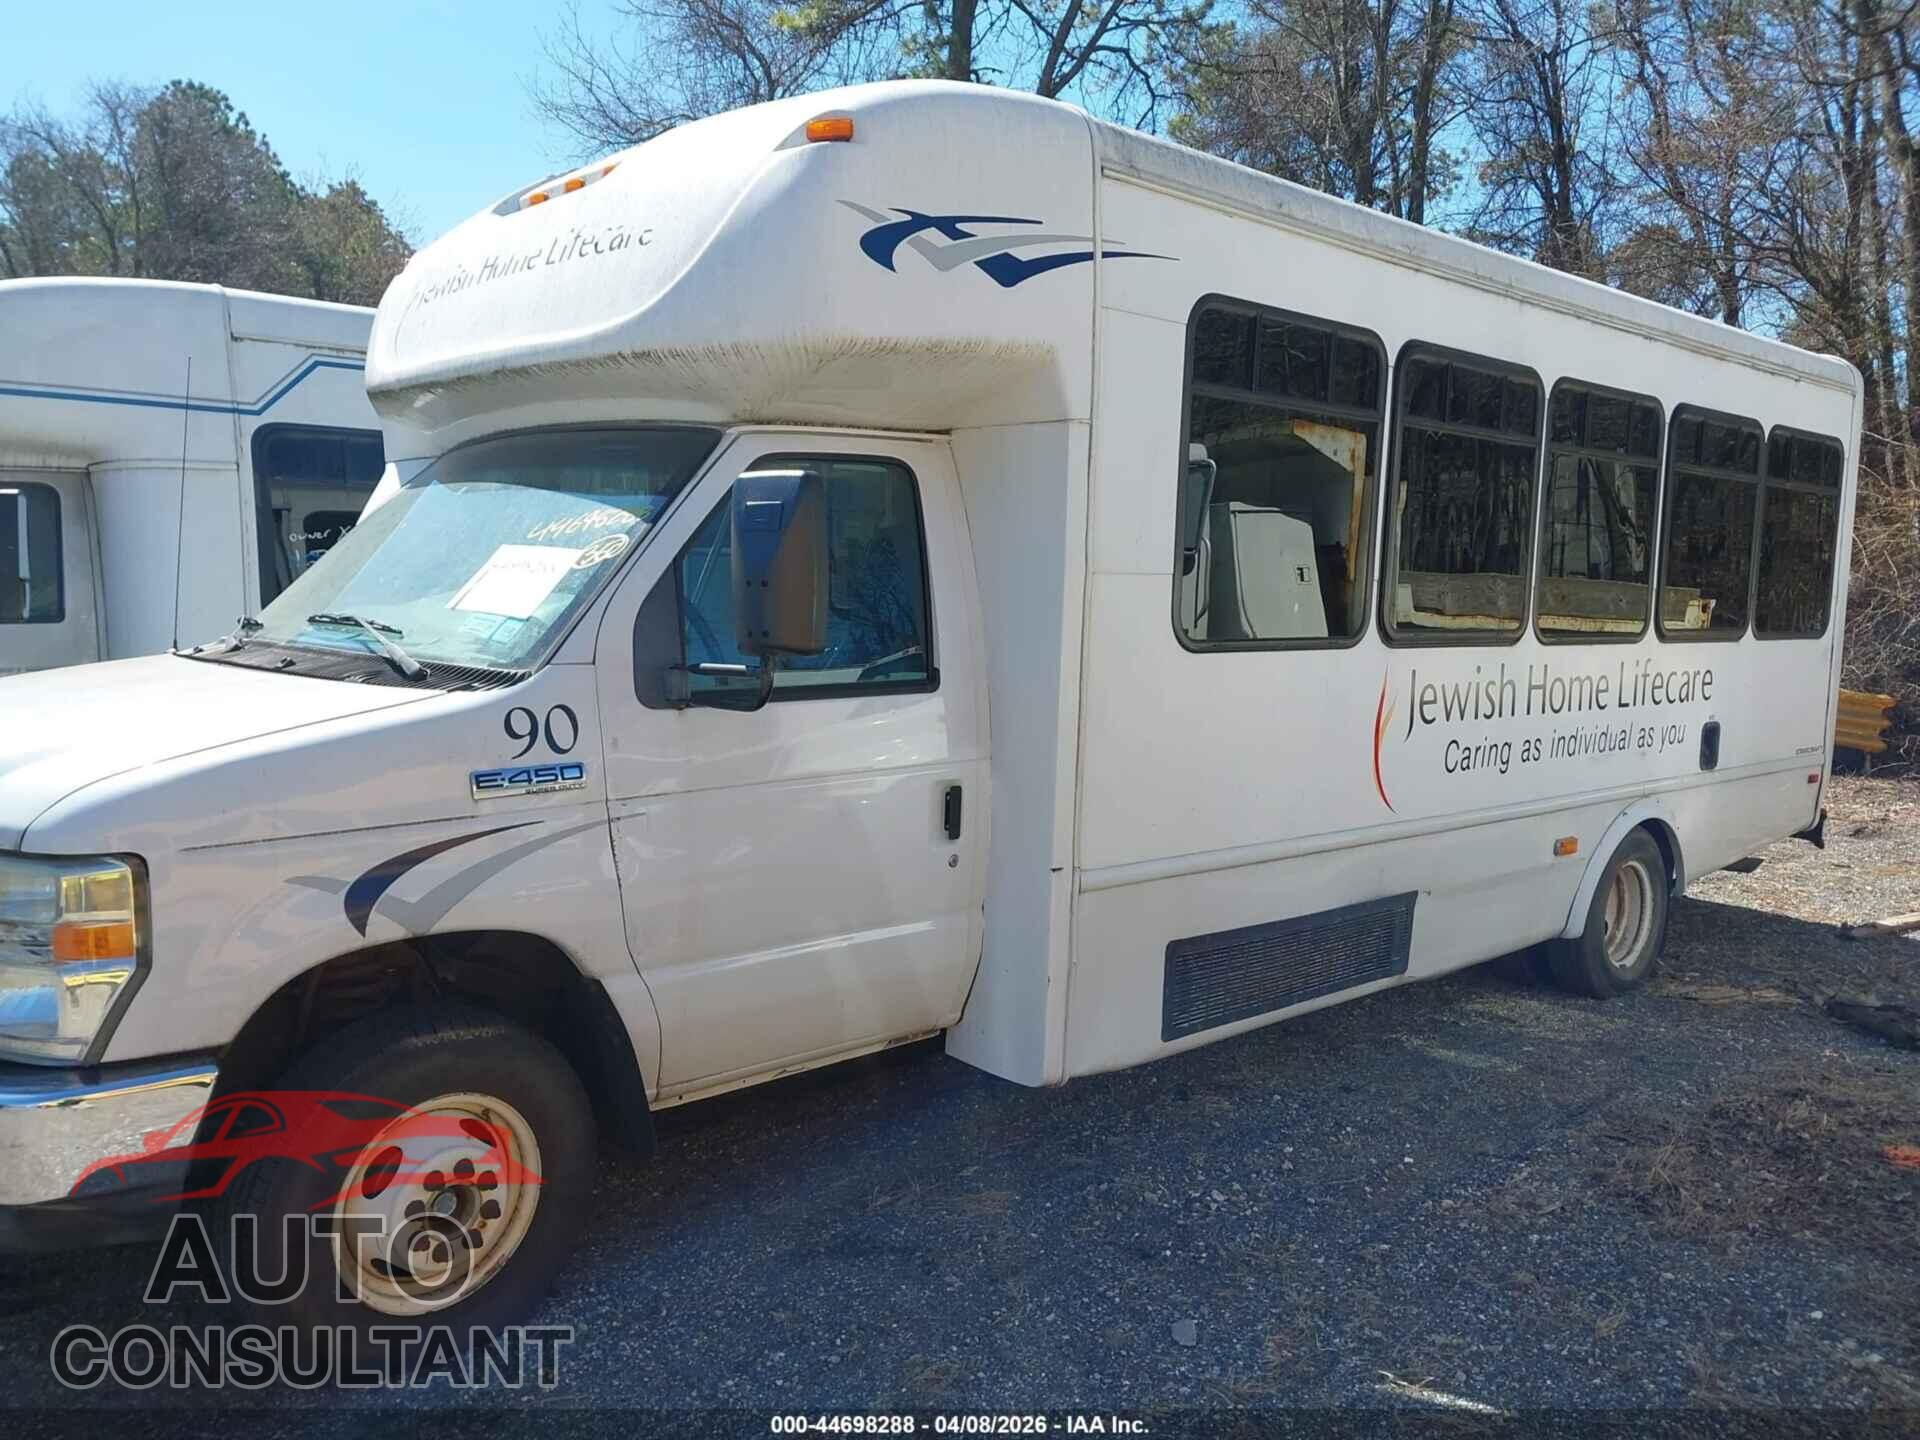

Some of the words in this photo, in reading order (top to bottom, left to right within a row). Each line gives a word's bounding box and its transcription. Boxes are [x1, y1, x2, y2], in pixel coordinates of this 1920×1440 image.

[477, 249, 543, 285] Home
[545, 225, 654, 267] Lifecare
[1403, 662, 1516, 742] Jewish
[1526, 663, 1609, 717] Home
[1618, 658, 1714, 709] Lifecare
[503, 703, 580, 760] 90
[1444, 737, 1512, 774] Caring
[1520, 737, 1542, 764] as
[1550, 722, 1634, 760] individual
[1637, 726, 1655, 750] as
[1659, 723, 1687, 755] you
[476, 765, 584, 790] E-450
